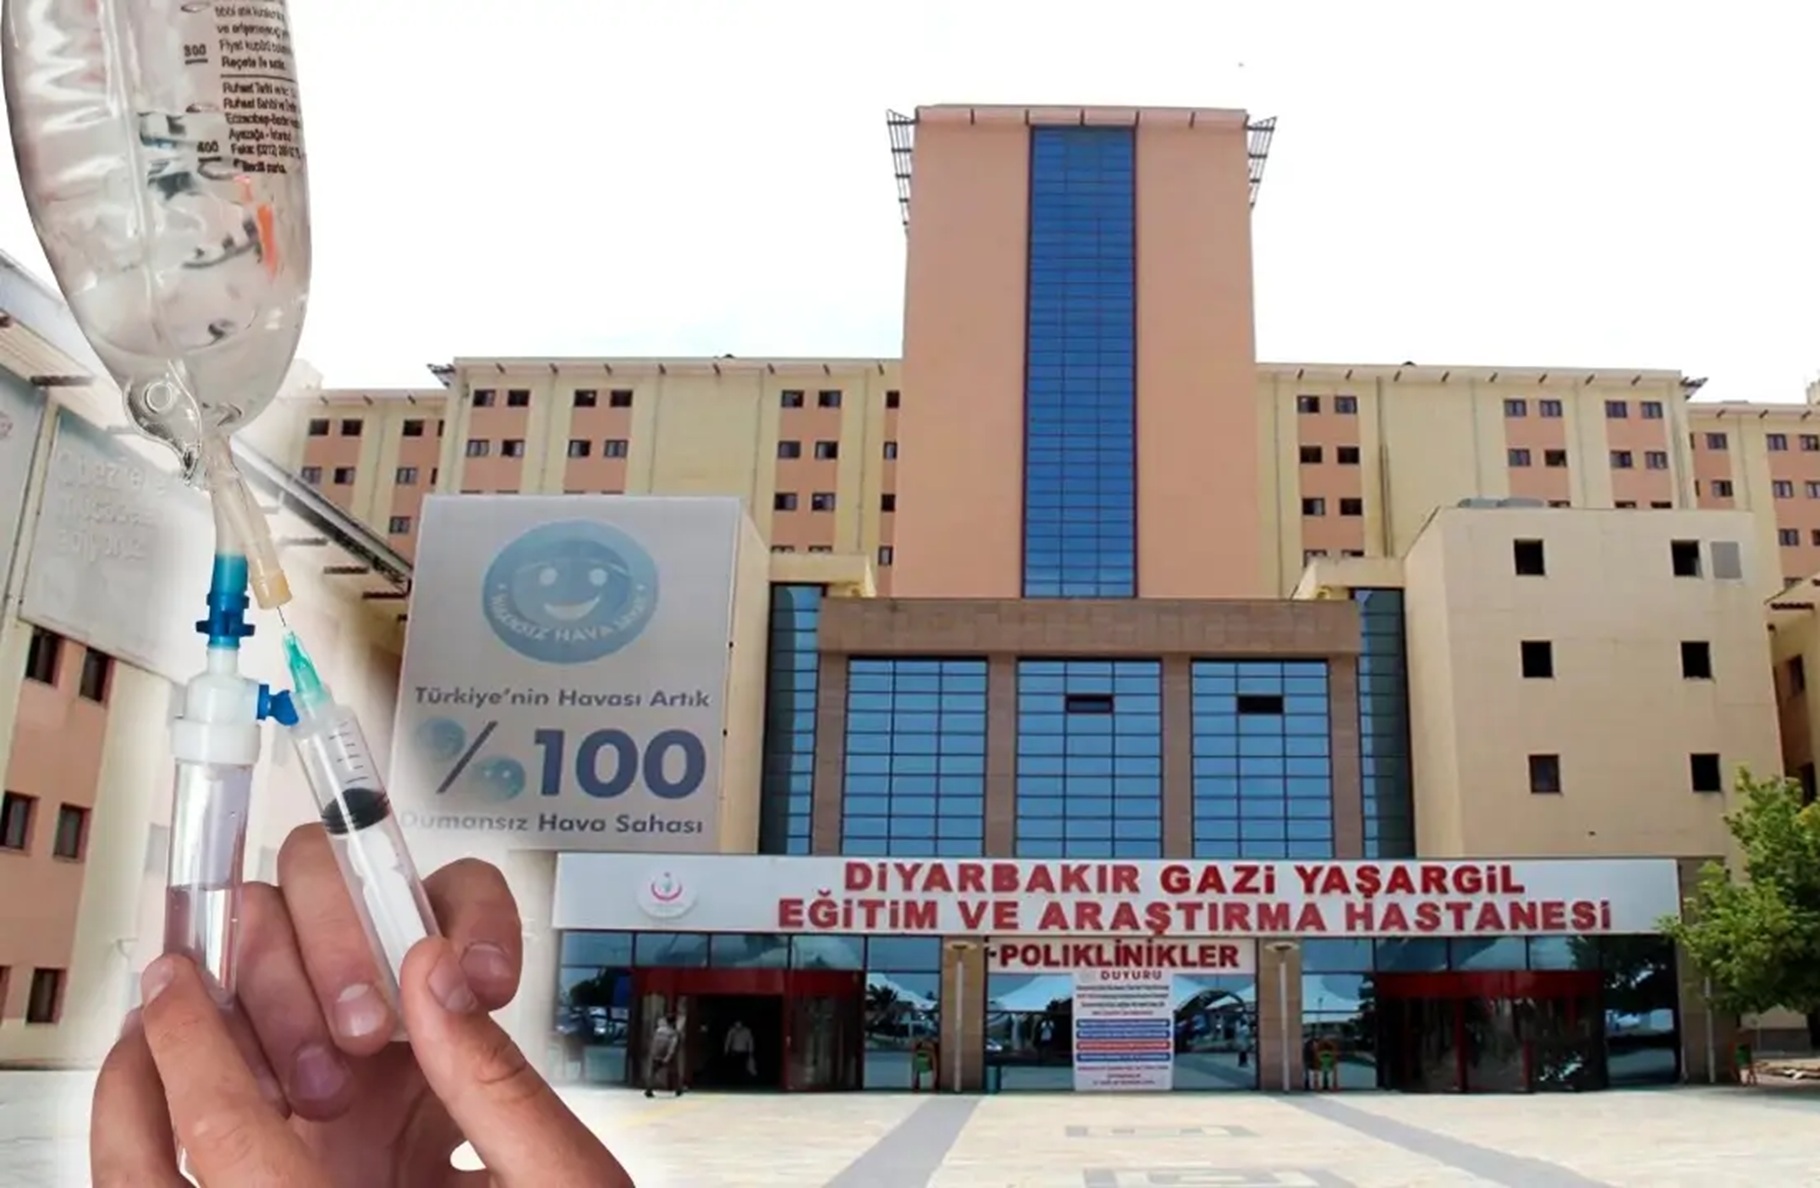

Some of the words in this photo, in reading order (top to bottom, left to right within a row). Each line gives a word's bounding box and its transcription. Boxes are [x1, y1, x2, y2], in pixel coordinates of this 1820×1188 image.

[558, 689, 642, 707] Havası
[649, 690, 711, 707] Artık
[538, 813, 606, 832] Hava
[616, 814, 703, 834] Sahası
[957, 900, 1018, 930] VE
[1038, 901, 1327, 936] ARAŞTIRMA
[1101, 970, 1162, 980] DUYURU
